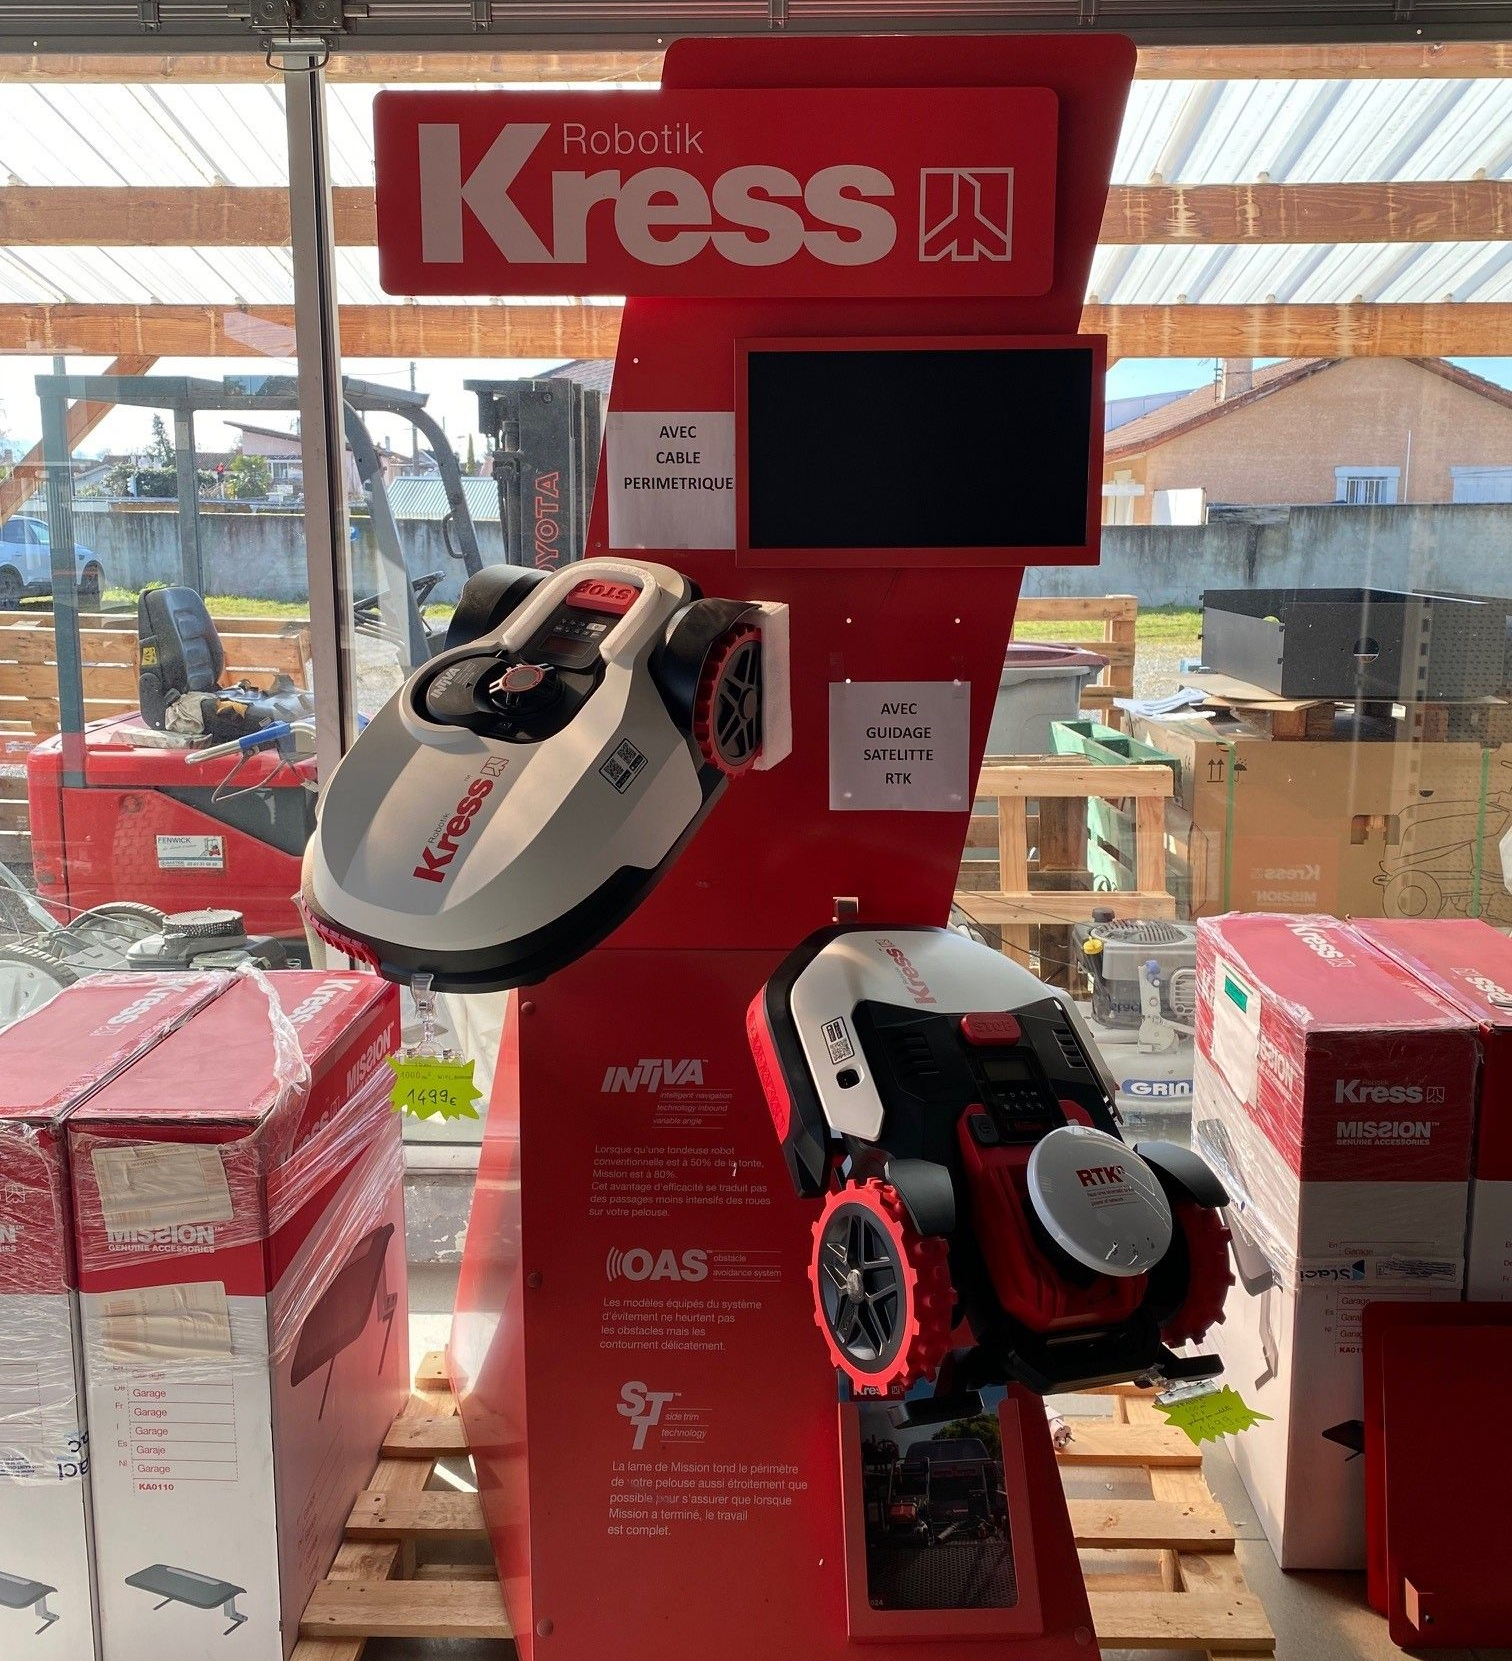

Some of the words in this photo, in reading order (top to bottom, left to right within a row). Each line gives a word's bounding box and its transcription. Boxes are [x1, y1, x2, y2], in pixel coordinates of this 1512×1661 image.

[562, 122, 704, 155] Robotik
[418, 122, 898, 267] Kress
[659, 425, 697, 439] AVEC
[656, 451, 701, 464] CABLE
[624, 477, 733, 491] PERIMETRIQUE
[535, 471, 559, 571] YOTA
[880, 702, 918, 715] AVEC
[866, 726, 932, 739] GUIDAGE
[863, 749, 934, 761] SATELITTE
[885, 772, 912, 784] RTK
[413, 778, 494, 883] Kress
[428, 811, 450, 844] Robotik
[1286, 923, 1344, 966] Kress
[886, 947, 937, 1005] Kress
[108, 980, 188, 1026] Kress
[601, 1058, 704, 1092] INTIVA
[1130, 1082, 1190, 1096] GRIN
[1335, 1079, 1423, 1104] Kress
[407, 1088, 457, 1106] 1499€
[698, 1104, 728, 1112] inbound
[1336, 1121, 1432, 1138] MISSION
[595, 1145, 632, 1155] Lorsque
[633, 1146, 665, 1155] qu'une
[667, 1146, 709, 1155] tondeuse
[711, 1146, 735, 1155] robot
[593, 1158, 664, 1166] conventionnelle
[666, 1159, 680, 1167] est
[690, 1159, 711, 1167] 50%
[714, 1159, 727, 1167] de
[738, 1159, 764, 1168] tonte.
[592, 1170, 627, 1179] Mission
[629, 1171, 644, 1179] est
[591, 1182, 607, 1191] Cet
[609, 1183, 652, 1193] avantage
[654, 1182, 704, 1192] d'efficacité
[719, 1183, 748, 1193] traduit
[751, 1185, 767, 1194] pas
[590, 1195, 607, 1203] des
[609, 1196, 653, 1206] passages
[656, 1196, 684, 1204] moins
[686, 1195, 723, 1205] intensifs
[726, 1196, 743, 1205] des
[745, 1197, 771, 1206] roues
[589, 1208, 603, 1216] sur
[606, 1208, 630, 1216] votre
[632, 1207, 670, 1218] pelouse.
[107, 1225, 215, 1245] MISSION
[108, 1244, 151, 1252] GENUINE
[152, 1245, 215, 1254] ACCESSORIES
[713, 1254, 747, 1263] obstacle
[621, 1248, 709, 1282] OAS
[712, 1269, 752, 1277] avoidance
[753, 1269, 781, 1278] system
[603, 1298, 620, 1307] Les
[623, 1298, 663, 1308] modèles
[666, 1298, 703, 1310] équipés
[706, 1300, 719, 1309] du
[722, 1299, 762, 1311] système
[602, 1312, 658, 1321] d'évitement
[660, 1314, 673, 1322] ne
[675, 1312, 714, 1322] heurtent
[717, 1315, 736, 1324] pas
[601, 1326, 615, 1335] les
[617, 1326, 664, 1336] obstacles
[666, 1327, 689, 1336] mais
[692, 1327, 706, 1336] les
[600, 1340, 659, 1349] contournent
[661, 1340, 727, 1351] délicatement.
[132, 1388, 166, 1400] Garage
[115, 1401, 124, 1410] Fr
[134, 1407, 167, 1418] Garage
[665, 1412, 682, 1421] side
[683, 1412, 699, 1421] trim
[135, 1426, 169, 1437] Garage
[661, 1429, 707, 1439] technology
[117, 1439, 128, 1448] Es
[136, 1446, 166, 1456] Garaje
[137, 1464, 171, 1475] Garage
[612, 1460, 625, 1471] La
[627, 1461, 652, 1471] lame
[655, 1462, 668, 1472] de
[670, 1462, 710, 1473] Mission
[712, 1463, 736, 1473] tond
[738, 1463, 748, 1473] le
[750, 1464, 799, 1475] périmètre
[138, 1483, 175, 1491] KA0110
[611, 1477, 624, 1487] de
[655, 1478, 696, 1489] pelouse
[698, 1479, 725, 1488] aussi
[727, 1479, 786, 1490] étroitement
[788, 1482, 808, 1491] que
[609, 1493, 652, 1504] possible
[682, 1494, 729, 1504] s'assurer
[731, 1498, 751, 1506] que
[753, 1496, 792, 1506] lorsque
[609, 1509, 648, 1519] Mission
[704, 1511, 714, 1520] le
[717, 1511, 748, 1521] travail
[607, 1526, 624, 1535] est
[626, 1526, 672, 1537] complet.
